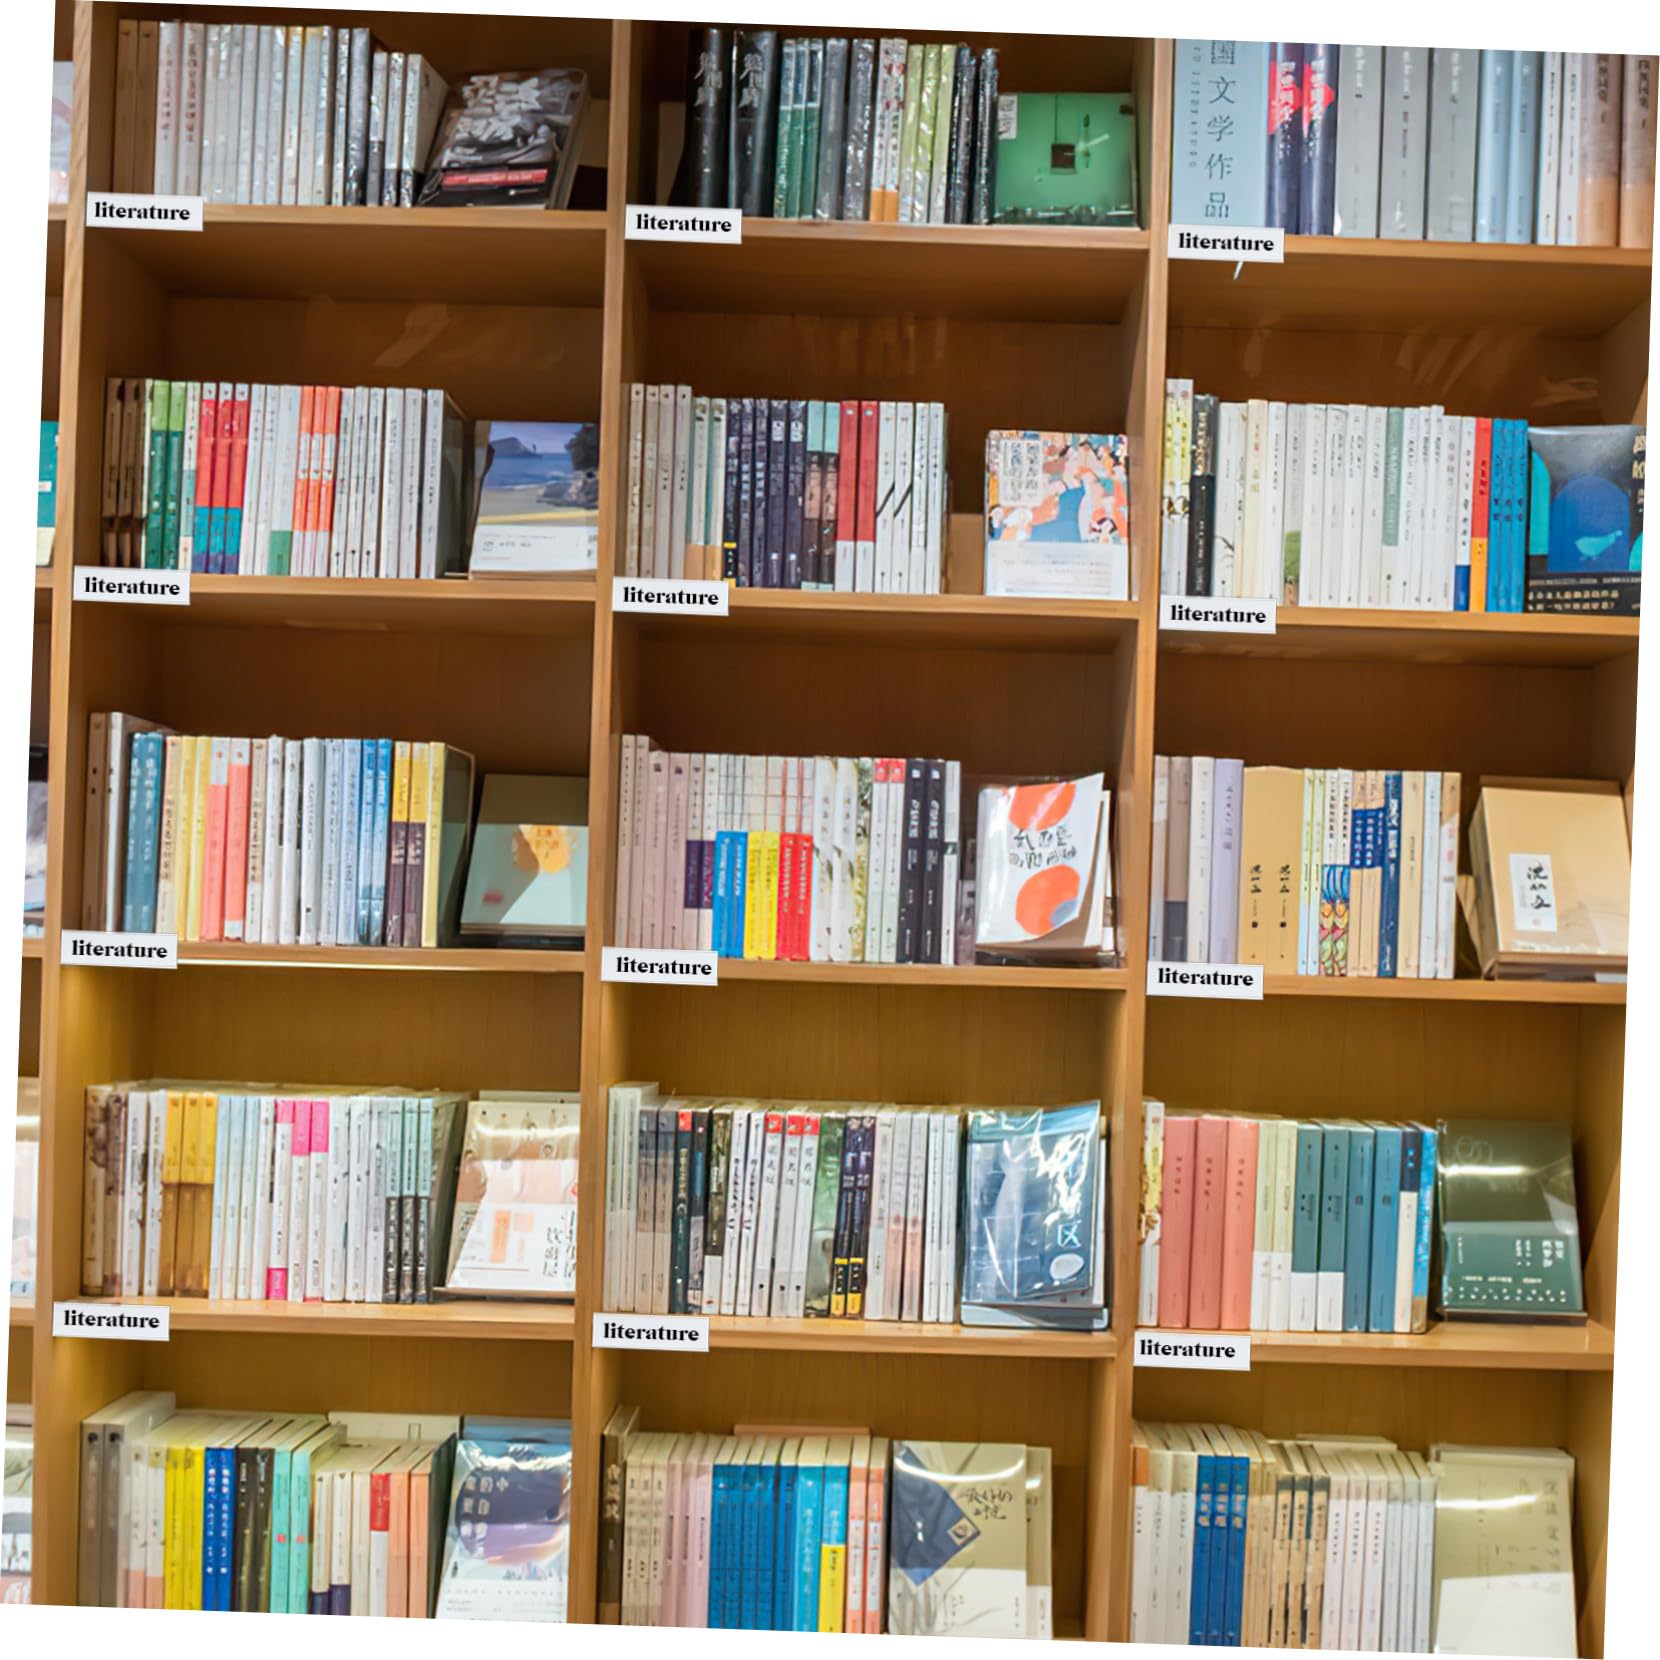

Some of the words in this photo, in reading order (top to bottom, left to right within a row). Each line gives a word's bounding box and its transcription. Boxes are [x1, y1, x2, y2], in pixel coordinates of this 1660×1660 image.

[95, 201, 190, 221] literature
[636, 213, 732, 233] literature
[1179, 232, 1274, 252] literature
[85, 576, 180, 596] literature
[623, 586, 719, 606] literature
[1171, 604, 1266, 624] literature
[72, 939, 168, 959] literature
[616, 956, 712, 976] literature
[1158, 967, 1254, 987] literature
[64, 1309, 160, 1329] literature
[604, 1322, 699, 1342] literature
[1140, 1339, 1236, 1358] literature
